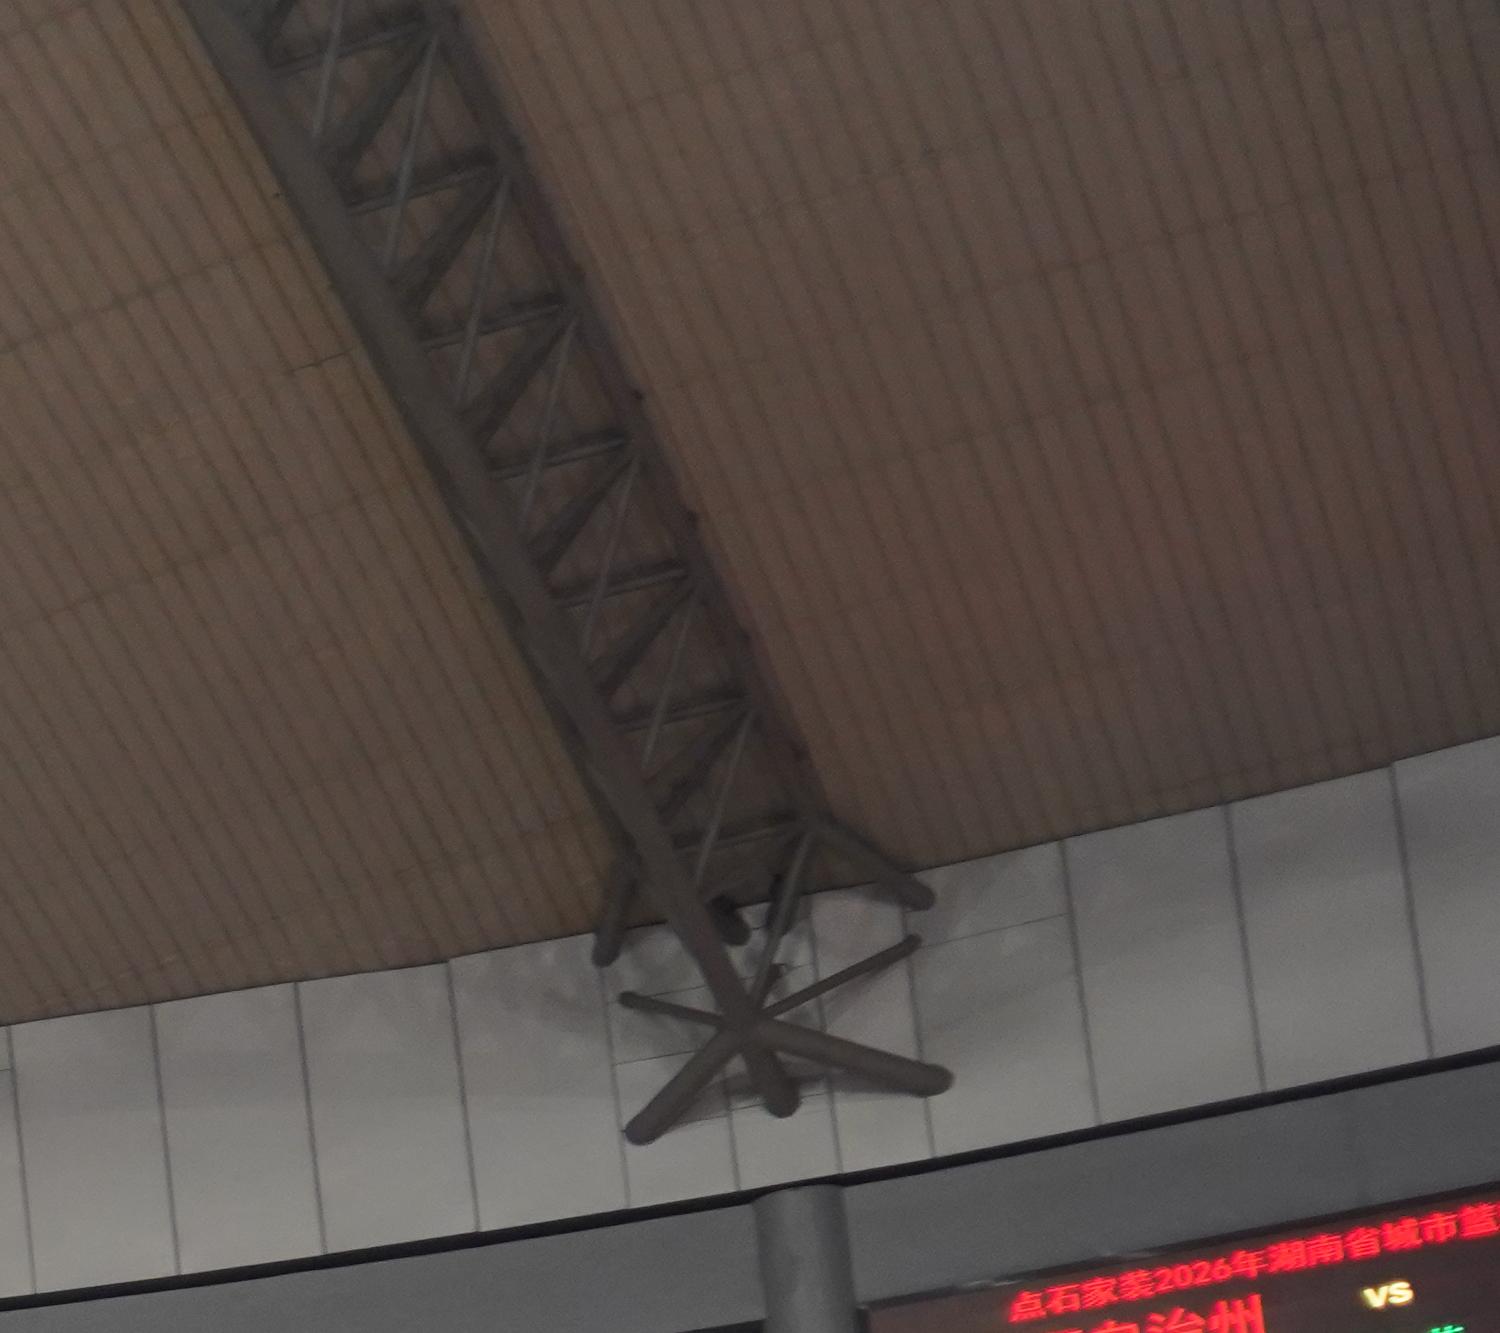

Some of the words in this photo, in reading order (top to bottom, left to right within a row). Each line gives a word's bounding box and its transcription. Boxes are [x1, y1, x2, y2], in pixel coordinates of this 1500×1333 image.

[1008, 1203, 1500, 1322] 点石家装2026年湖南省城市篮
